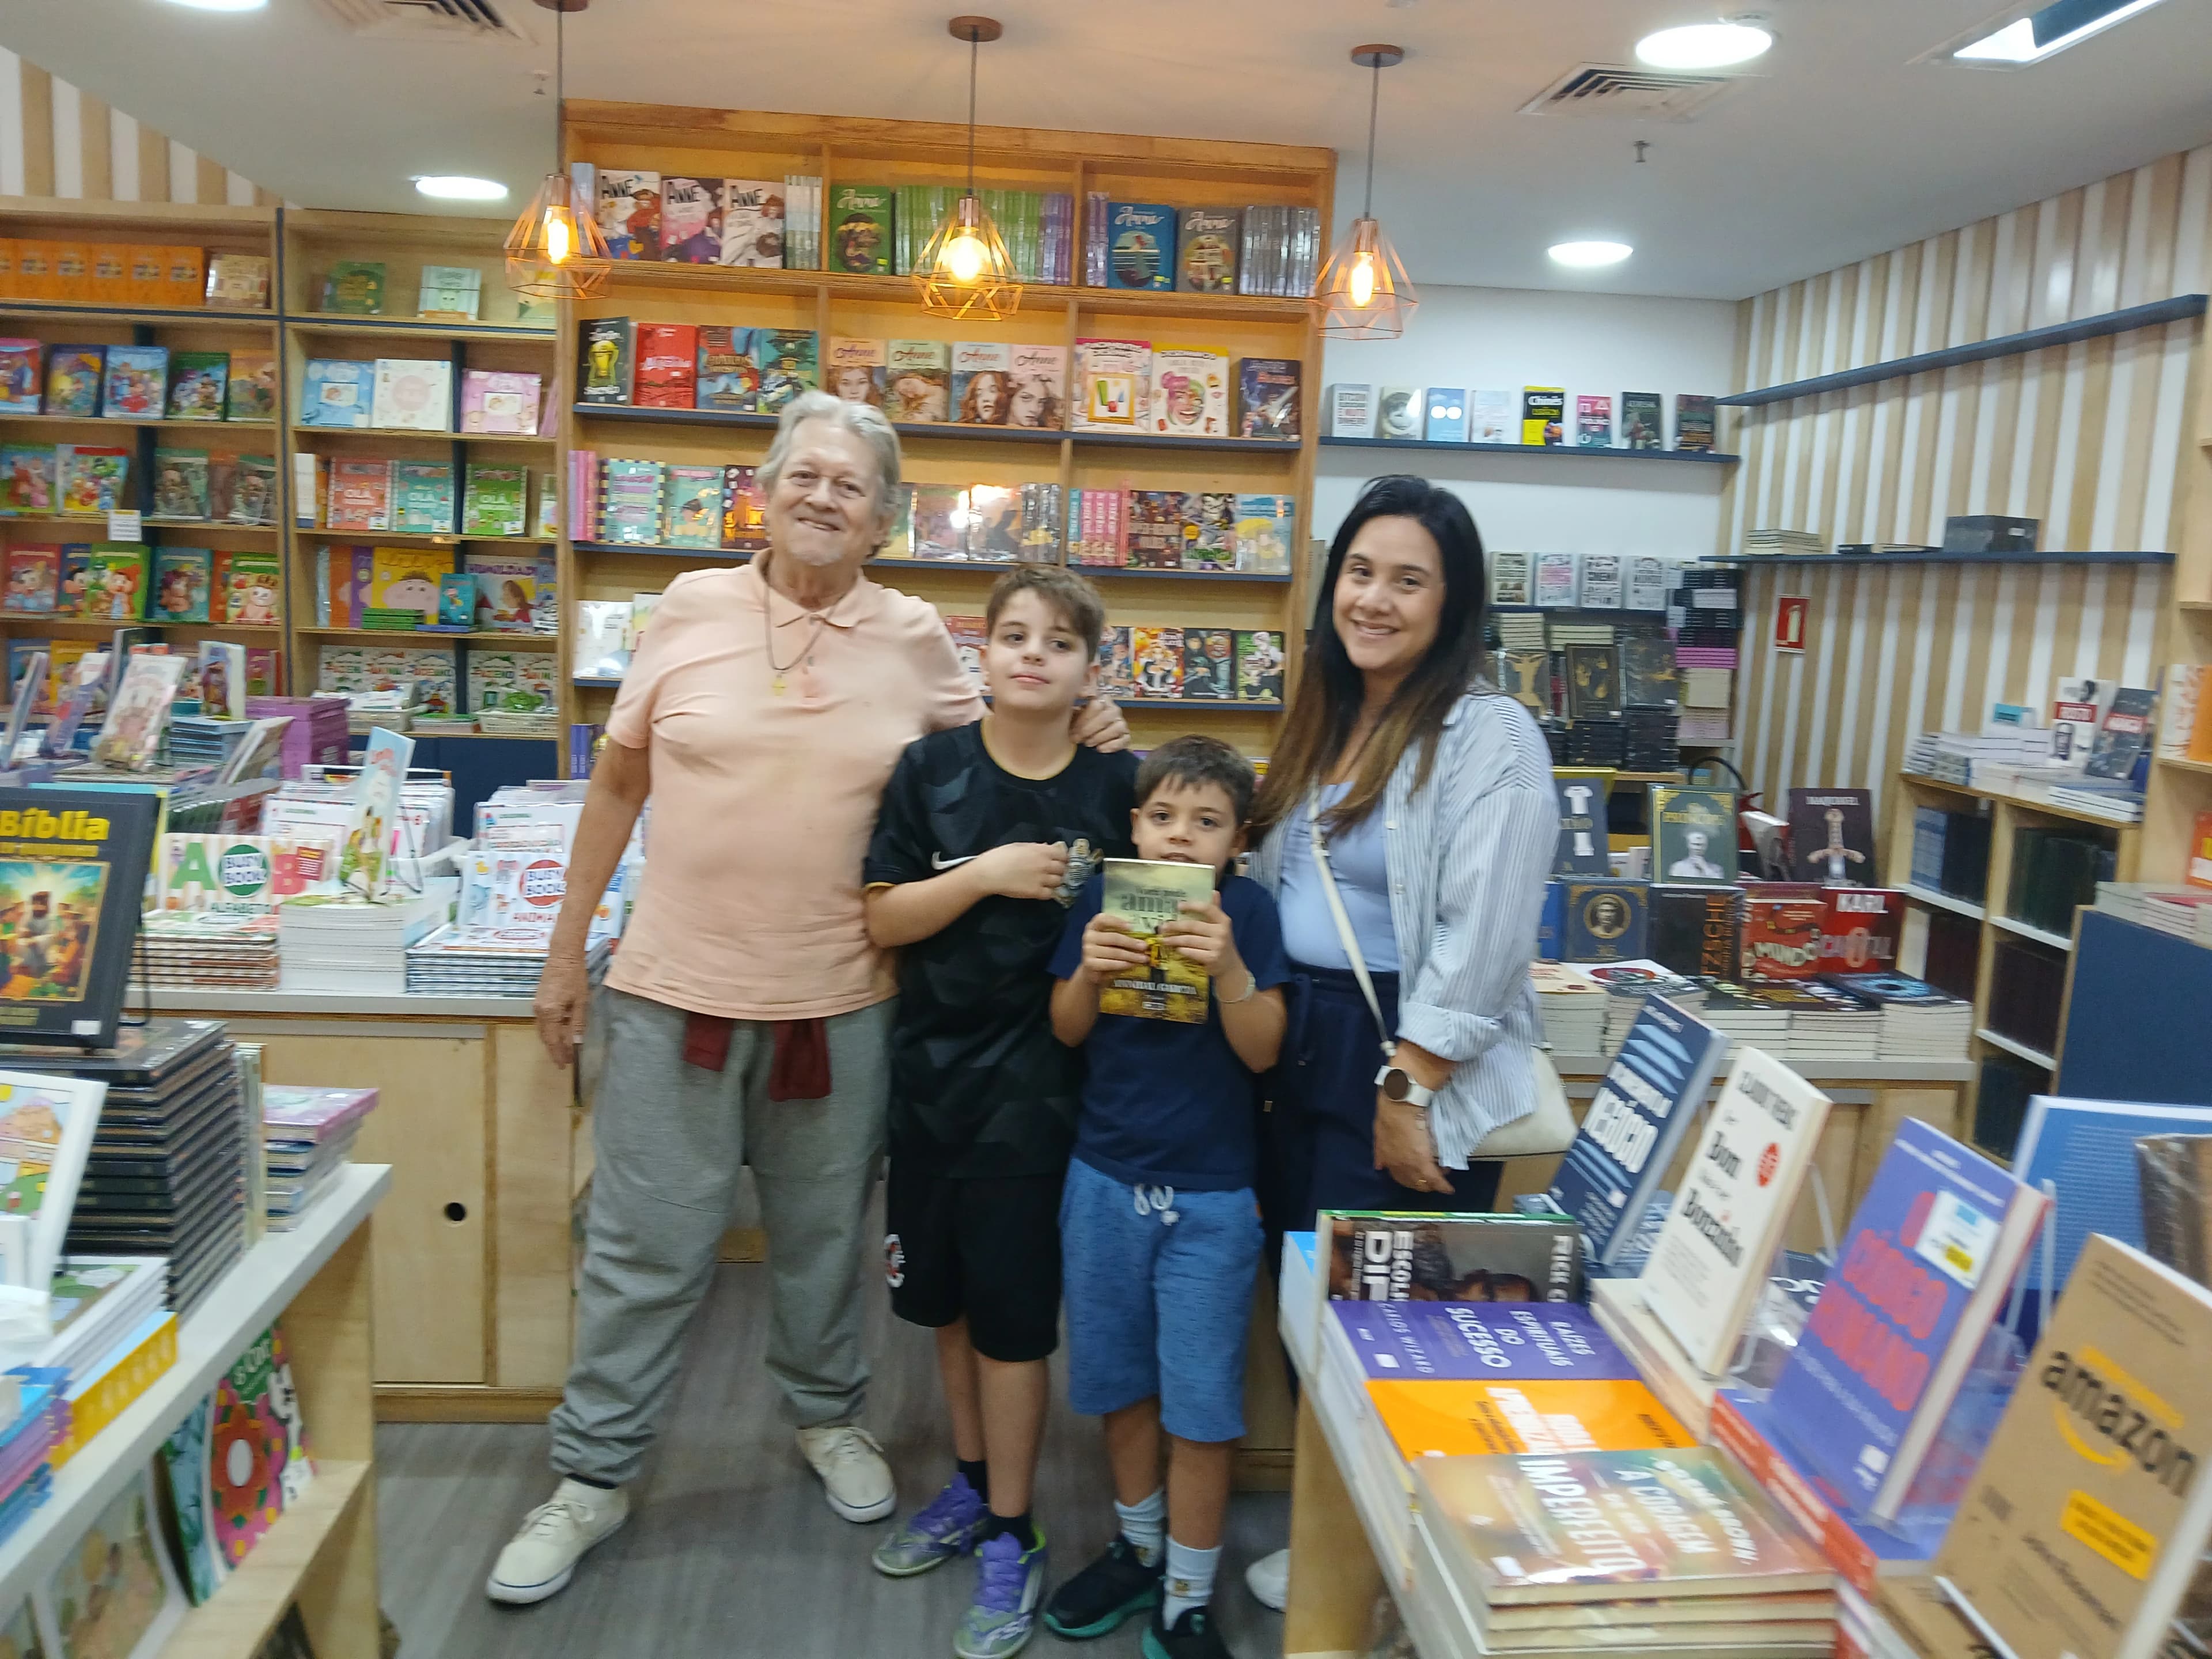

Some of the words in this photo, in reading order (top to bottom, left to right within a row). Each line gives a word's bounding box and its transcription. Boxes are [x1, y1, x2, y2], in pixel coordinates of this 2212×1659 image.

[1399, 1335, 1435, 1374] WIZARD
[1445, 1308, 1512, 1369] SUCESSO
[1494, 1328, 1526, 1346] DO
[1509, 1310, 1574, 1367] ESPIRITUAIS
[2040, 1350, 2198, 1497] amazon
[1613, 1469, 1657, 1482] A
[1517, 1459, 1648, 1571] IMPERFEITO
[1629, 1485, 1722, 1555] CORAGEM
